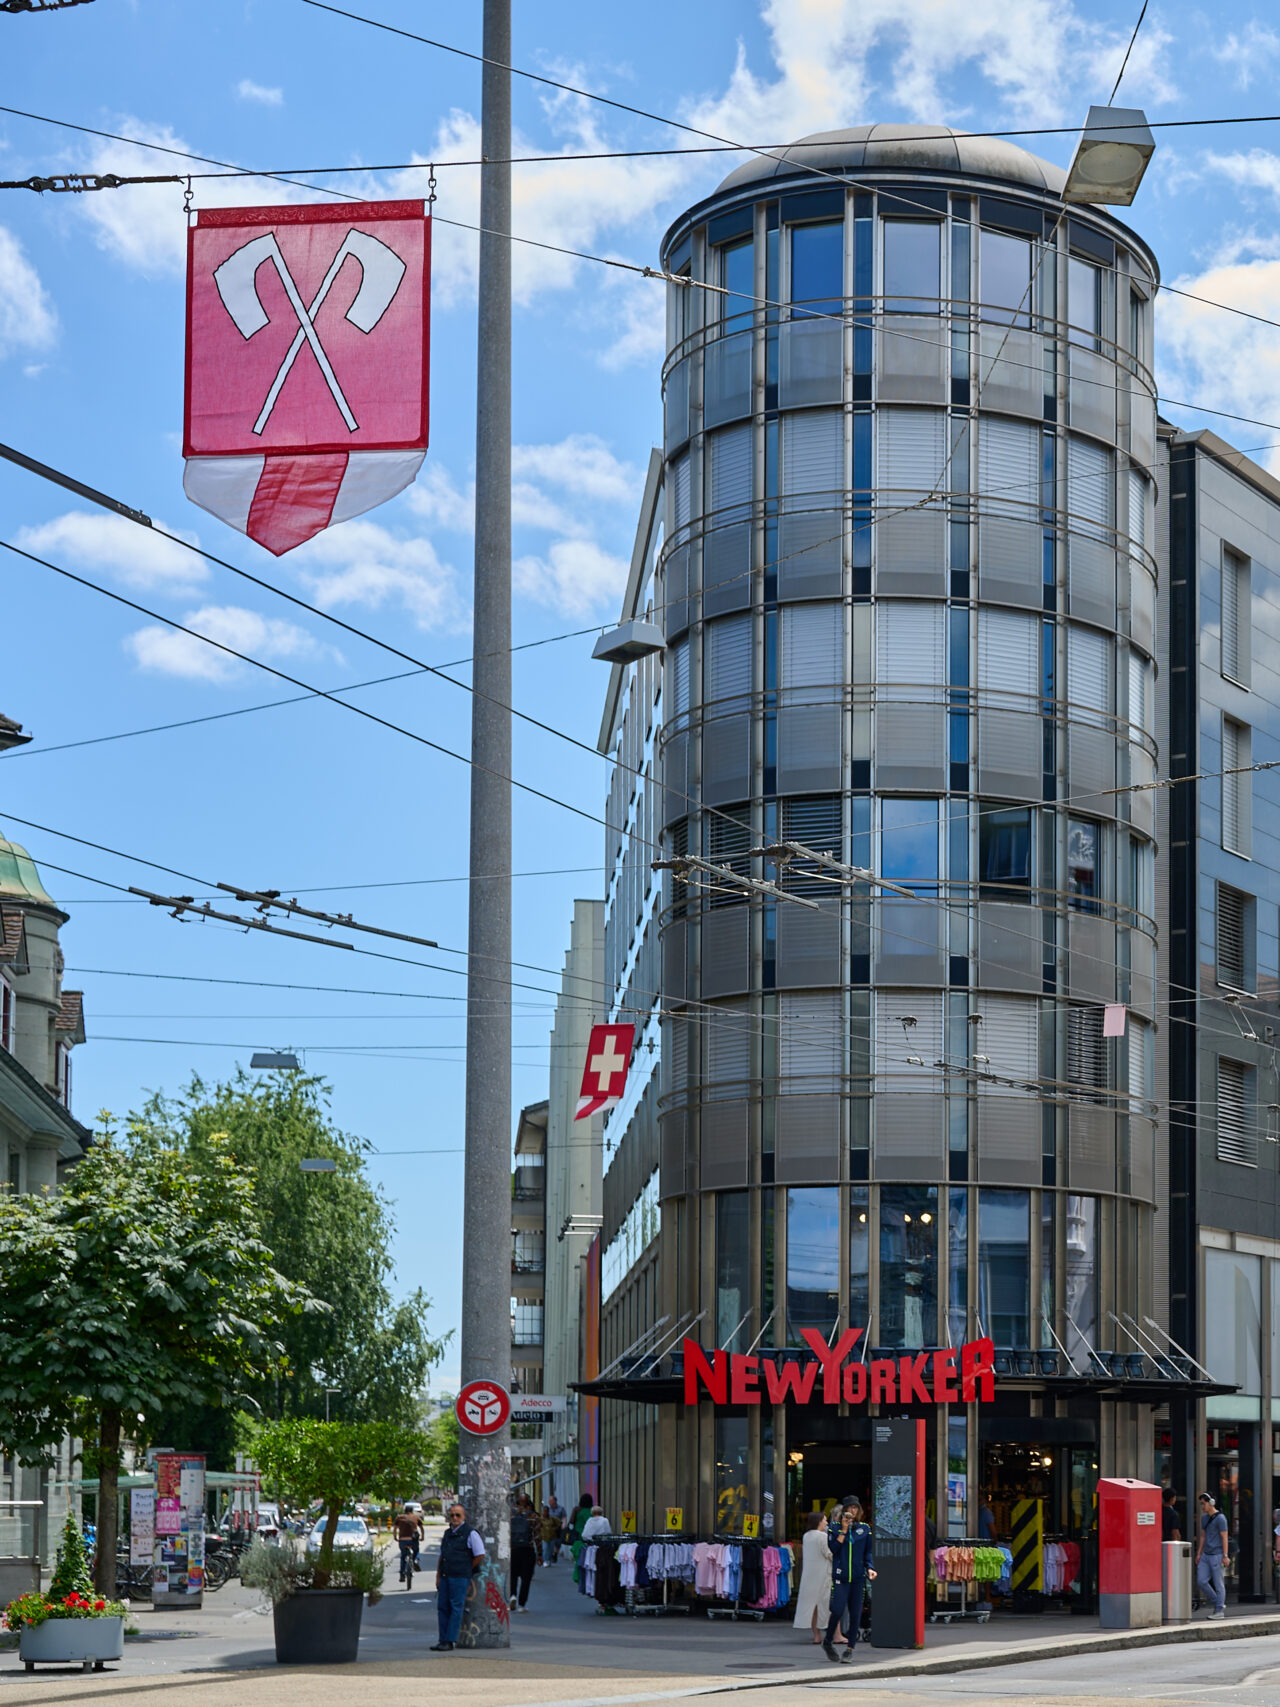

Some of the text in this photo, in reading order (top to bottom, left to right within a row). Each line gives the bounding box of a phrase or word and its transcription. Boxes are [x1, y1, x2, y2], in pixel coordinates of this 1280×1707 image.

[521, 1399, 553, 1407] Adecco
[624, 1517, 631, 1529] 7
[671, 1514, 678, 1525] 6
[746, 1521, 754, 1533] 4
